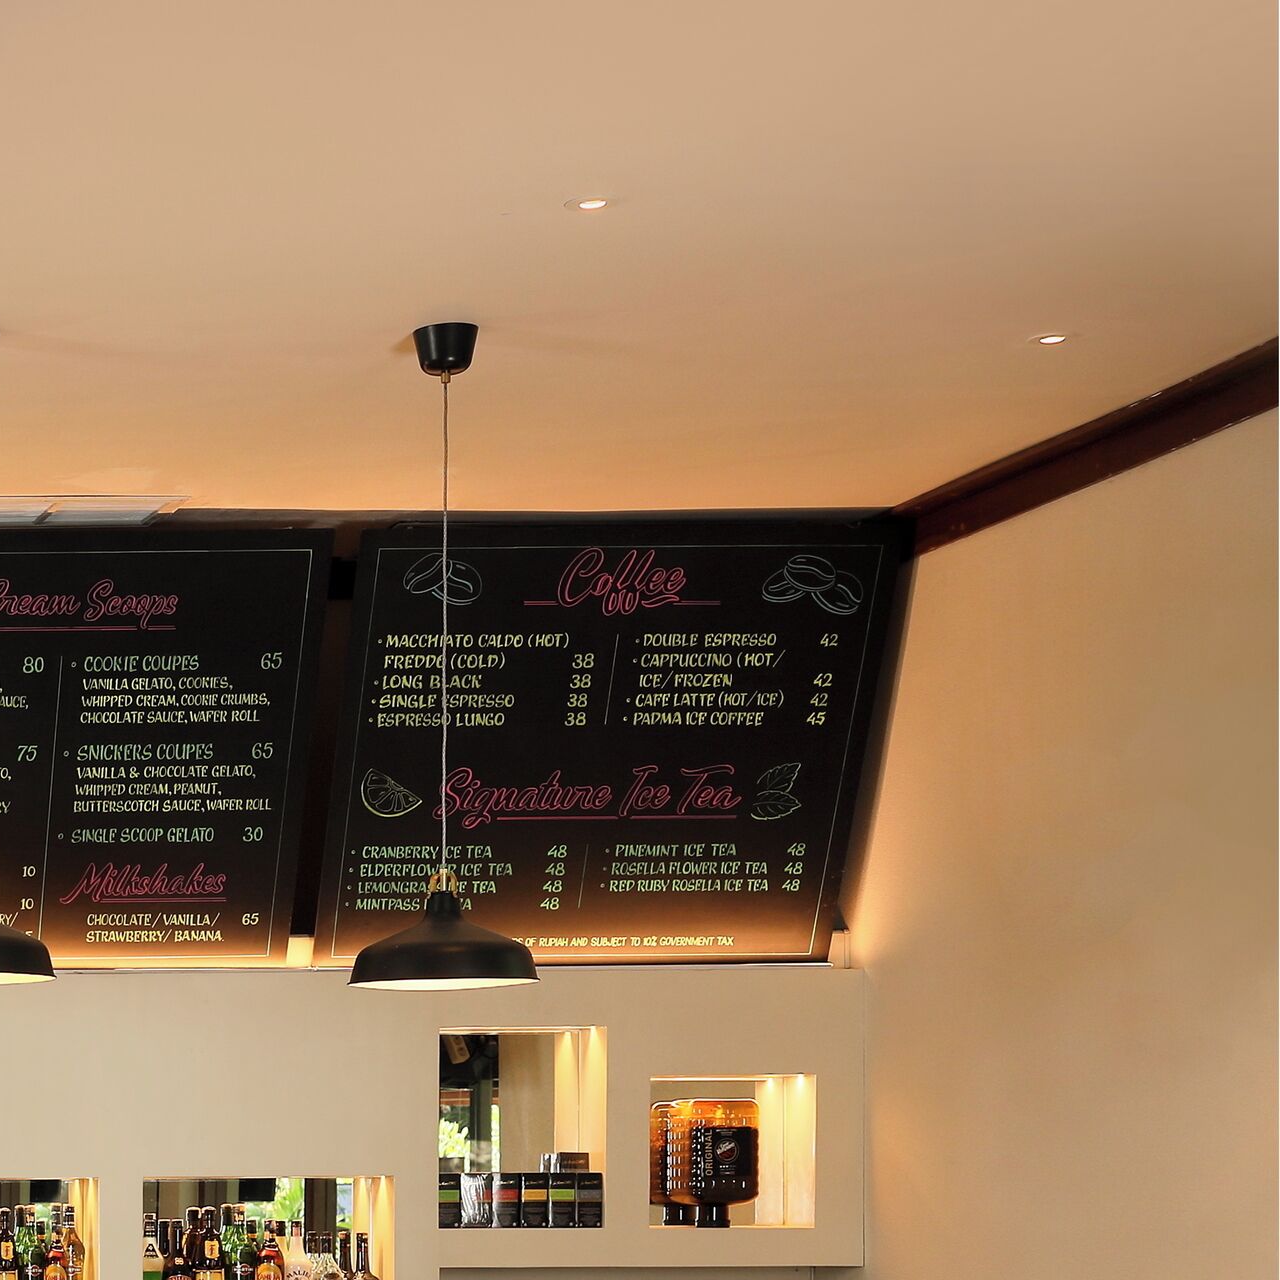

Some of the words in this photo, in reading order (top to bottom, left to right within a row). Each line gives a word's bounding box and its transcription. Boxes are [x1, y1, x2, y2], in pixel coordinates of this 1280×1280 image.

[558, 547, 686, 616] Coffee
[84, 578, 179, 628] Scoops
[643, 634, 698, 647] DOUBLE
[705, 634, 777, 646] ESPRESSO
[820, 634, 838, 646] 42
[23, 657, 44, 673] 80
[84, 656, 139, 672] COOKIE
[142, 655, 199, 671] COUPES
[261, 652, 282, 670] 65
[384, 654, 445, 669] FREDDO
[450, 652, 505, 670] (COLD)
[572, 653, 594, 669] 38
[641, 653, 732, 667] CAPPUCCINO
[83, 678, 129, 690] VANILLA
[131, 677, 175, 690] GELATO,
[179, 677, 233, 690] COOKIES,
[813, 673, 833, 687] 42
[82, 695, 132, 707] WHIPPED
[136, 695, 179, 707] CREAM,
[181, 694, 218, 706] COOKIE
[221, 693, 270, 706] CRUMBS,
[635, 693, 670, 708] CAFE
[673, 693, 715, 707] LATTE
[810, 693, 828, 707] 42
[377, 713, 451, 728] ESPRESSO
[455, 713, 505, 727] LUNGO
[564, 713, 586, 727] 38
[633, 712, 682, 726] PADMA
[686, 712, 707, 725] ICE
[710, 712, 764, 726] COFFEE
[806, 712, 826, 725] 45
[16, 745, 38, 761] 75
[77, 745, 152, 760] SNICKERS
[156, 744, 213, 760] COUPES
[252, 743, 273, 759] 65
[433, 767, 612, 828] Signature
[619, 765, 671, 816] Ice
[678, 764, 742, 809] Tea
[73, 800, 159, 812] BUTTERSCOTCH
[162, 799, 204, 812] SAUCE,
[207, 799, 243, 811] WAFER
[246, 799, 271, 810] ROLL
[71, 828, 117, 844] SINGLE
[120, 828, 163, 843] SCOOP
[167, 828, 214, 842] GELATO
[242, 827, 263, 842] 30
[615, 844, 678, 857] PINEMINT
[684, 844, 705, 856] ICE
[711, 844, 736, 856] TEA
[787, 843, 806, 856] 48
[22, 866, 35, 877] 10
[611, 862, 665, 875] ROSELLA
[669, 862, 717, 875] FLOWER
[720, 862, 740, 874] ICE
[745, 862, 767, 874] TEA
[784, 862, 803, 875] 48
[60, 862, 226, 902] Milkshakes
[525, 938, 537, 947] OF
[539, 938, 568, 947] RUPIAH
[569, 938, 588, 946] AND
[590, 937, 627, 946] SUBJECT
[631, 937, 640, 946] TO
[643, 937, 657, 945] 10%
[660, 937, 714, 946] GOVERNMENT
[717, 937, 734, 946] TAX
[705, 1129, 713, 1176] ORIGINAL
